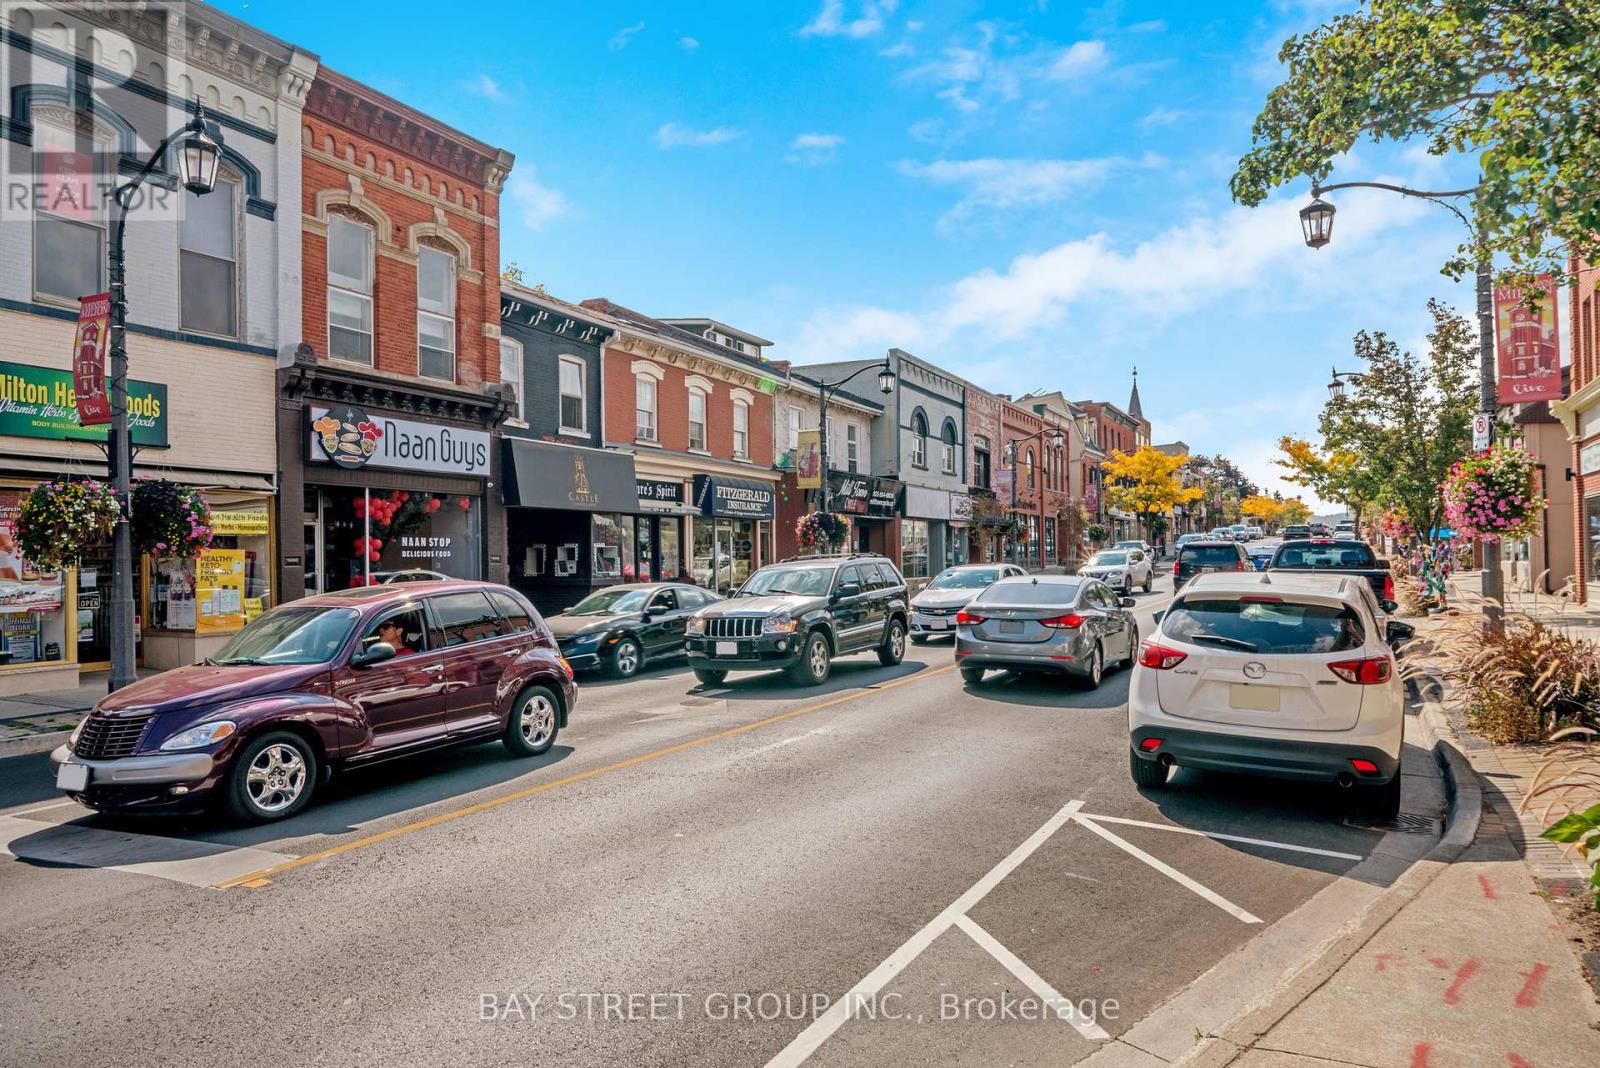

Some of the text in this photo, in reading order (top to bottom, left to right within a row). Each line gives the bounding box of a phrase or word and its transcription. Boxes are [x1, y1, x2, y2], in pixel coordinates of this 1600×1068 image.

[1498, 281, 1554, 301] MILN
[1512, 382, 1547, 395] Live
[127, 393, 160, 418] oods
[384, 420, 486, 471] Naan Guys
[568, 491, 600, 503] CASTLE
[656, 484, 676, 499] Spirit
[716, 485, 770, 503] FITZGERALD
[727, 500, 762, 511] INSURANCE
[401, 537, 451, 547] NAAN STOP
